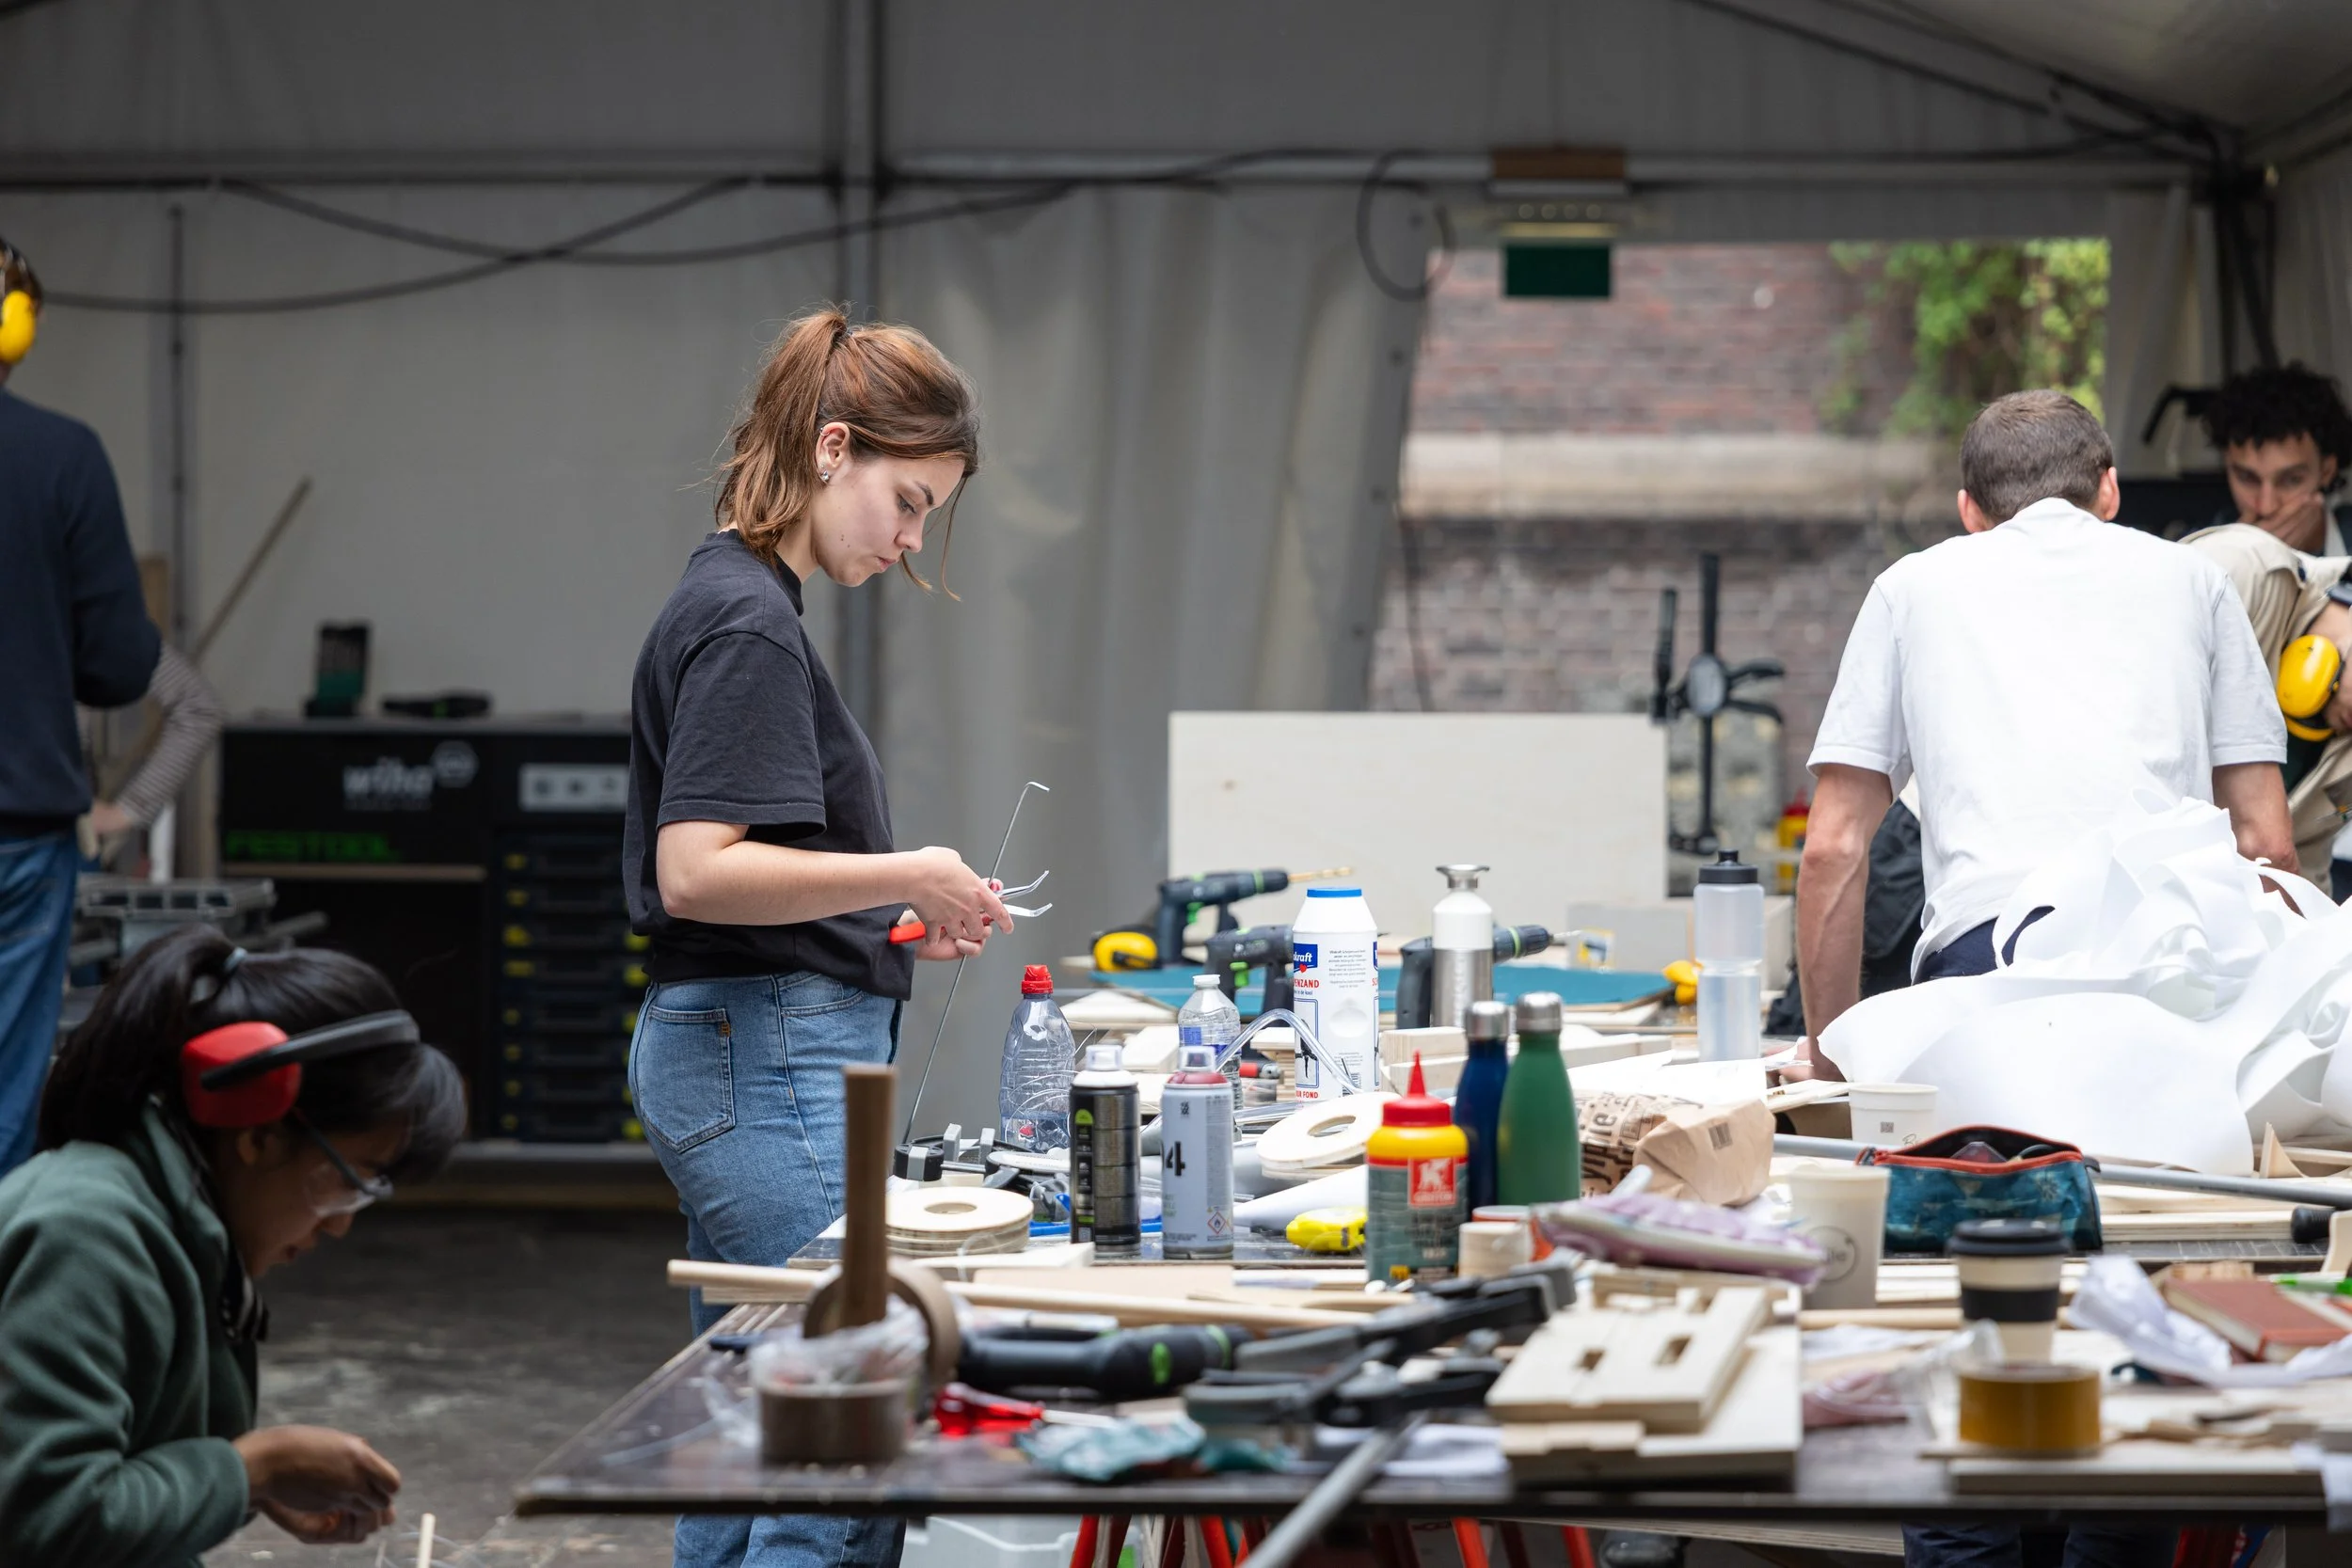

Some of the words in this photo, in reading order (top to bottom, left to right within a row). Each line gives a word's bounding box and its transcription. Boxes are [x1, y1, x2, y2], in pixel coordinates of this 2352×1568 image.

[1294, 978, 1319, 989] ENZAND
[1302, 1090, 1319, 1099] FOND
[1161, 1140, 1186, 1177] 4
